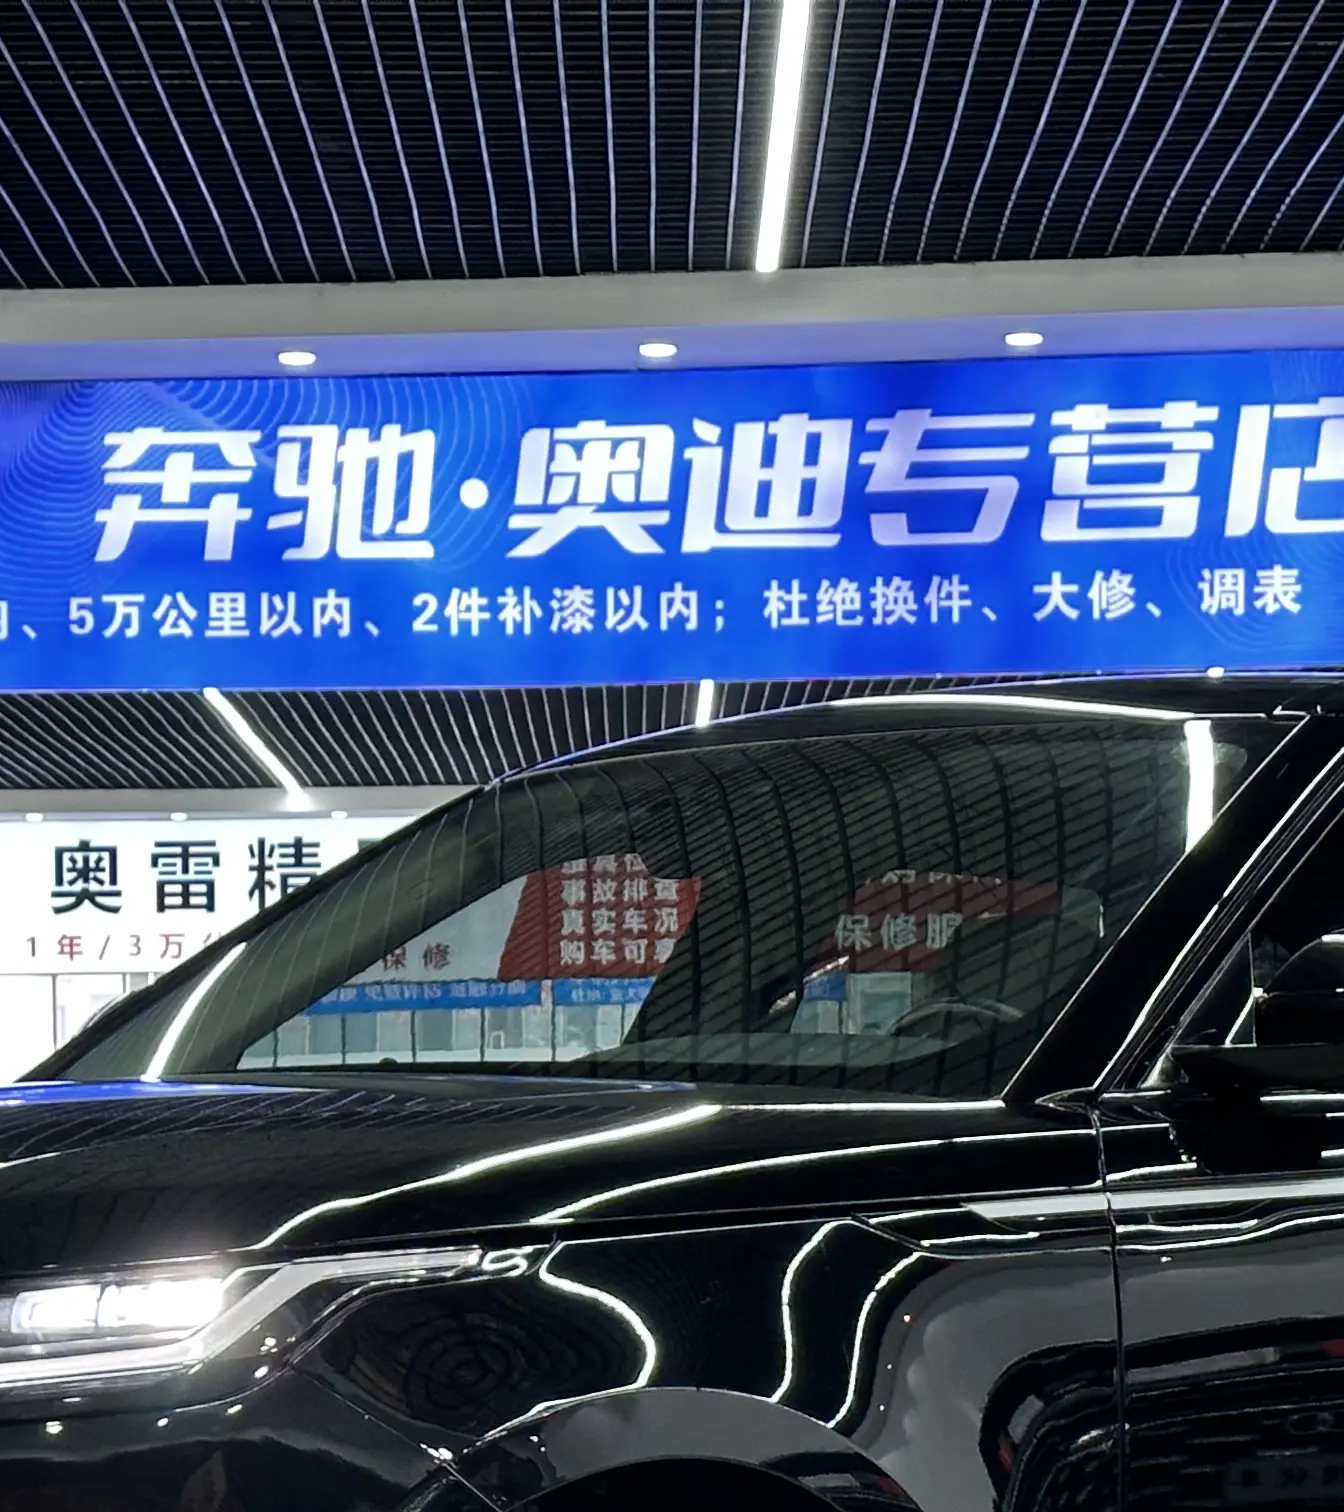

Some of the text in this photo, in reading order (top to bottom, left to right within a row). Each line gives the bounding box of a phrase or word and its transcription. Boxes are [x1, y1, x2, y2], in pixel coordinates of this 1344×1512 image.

[51, 836, 381, 914] 奥雷精
[26, 933, 223, 962] 1年/3万
